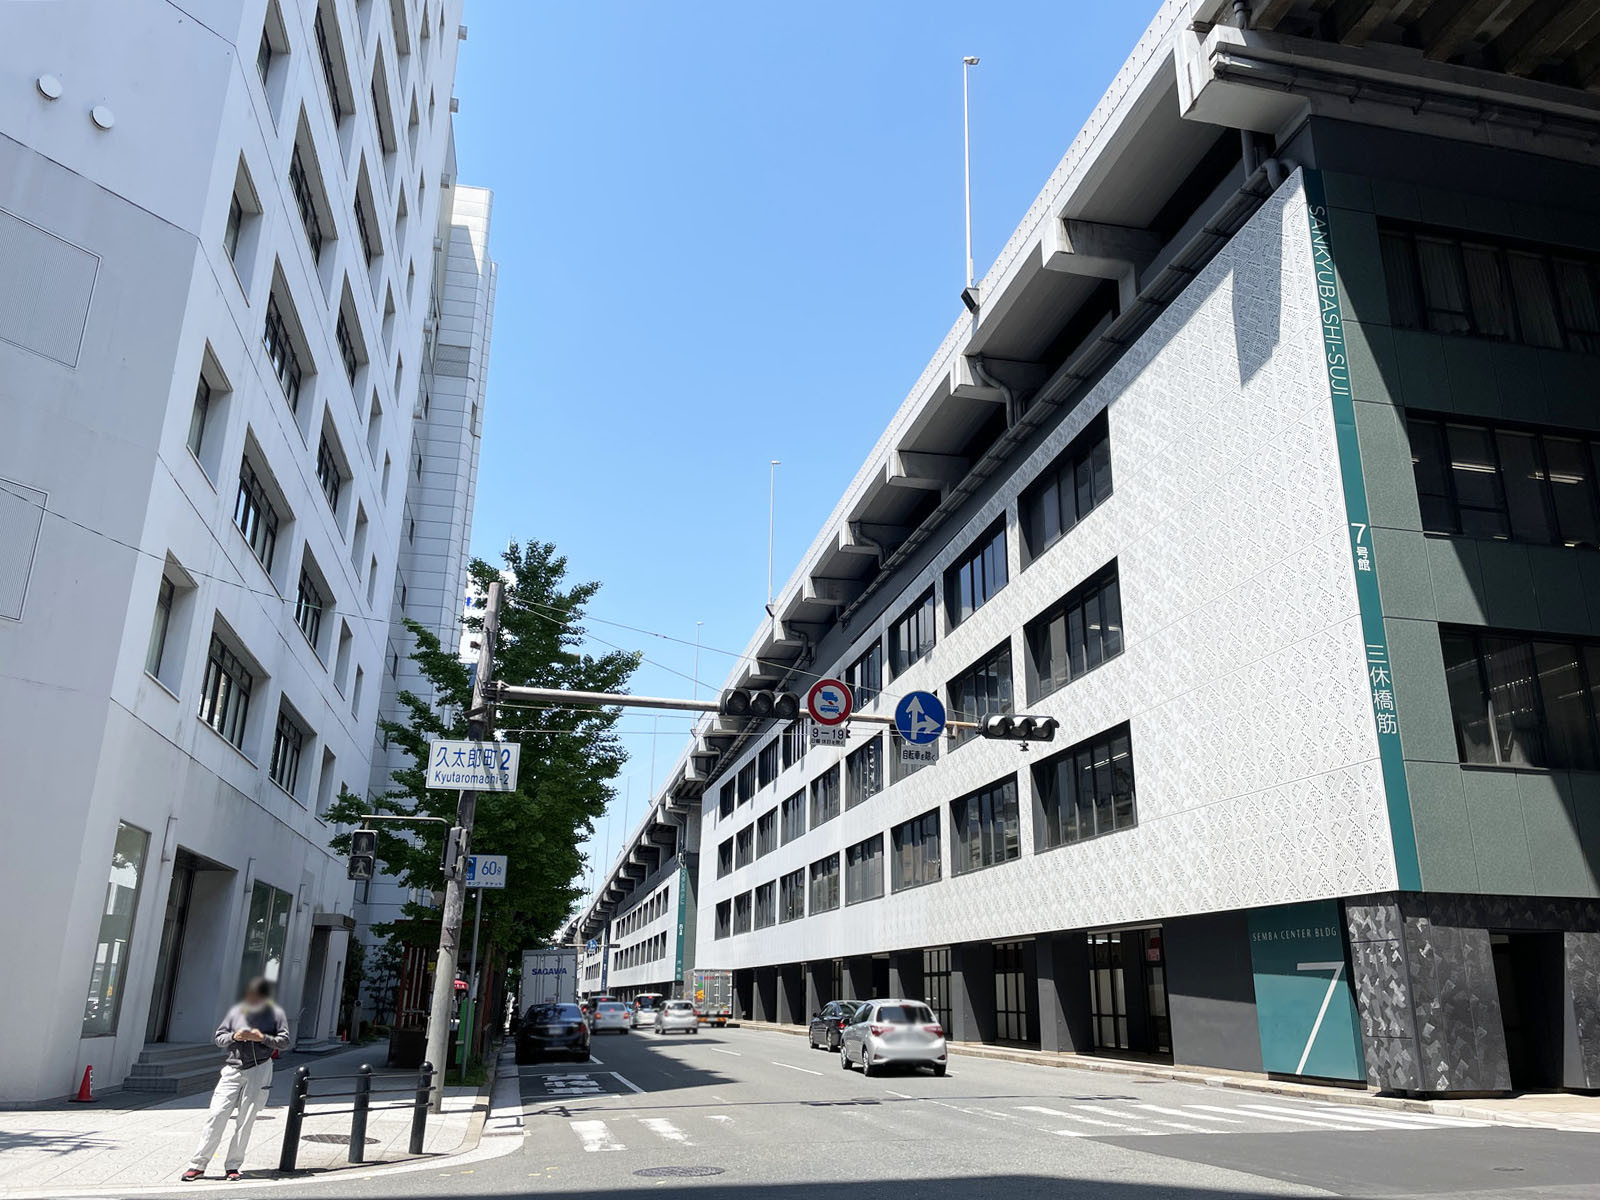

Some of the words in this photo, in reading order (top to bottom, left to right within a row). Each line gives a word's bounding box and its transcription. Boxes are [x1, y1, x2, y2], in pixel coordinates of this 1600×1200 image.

[1308, 204, 1349, 396] SANKYUBASHI-SUJI
[1350, 522, 1371, 572] 7号館
[1366, 643, 1397, 735] 三休橋筋
[434, 770, 510, 785] Kyutaromachi-2
[1252, 931, 1278, 942] SEMBA
[1280, 928, 1312, 940] CENTER
[1314, 926, 1337, 938] BLDG
[531, 967, 568, 976] SAGAWA
[1295, 961, 1345, 1075] 7
